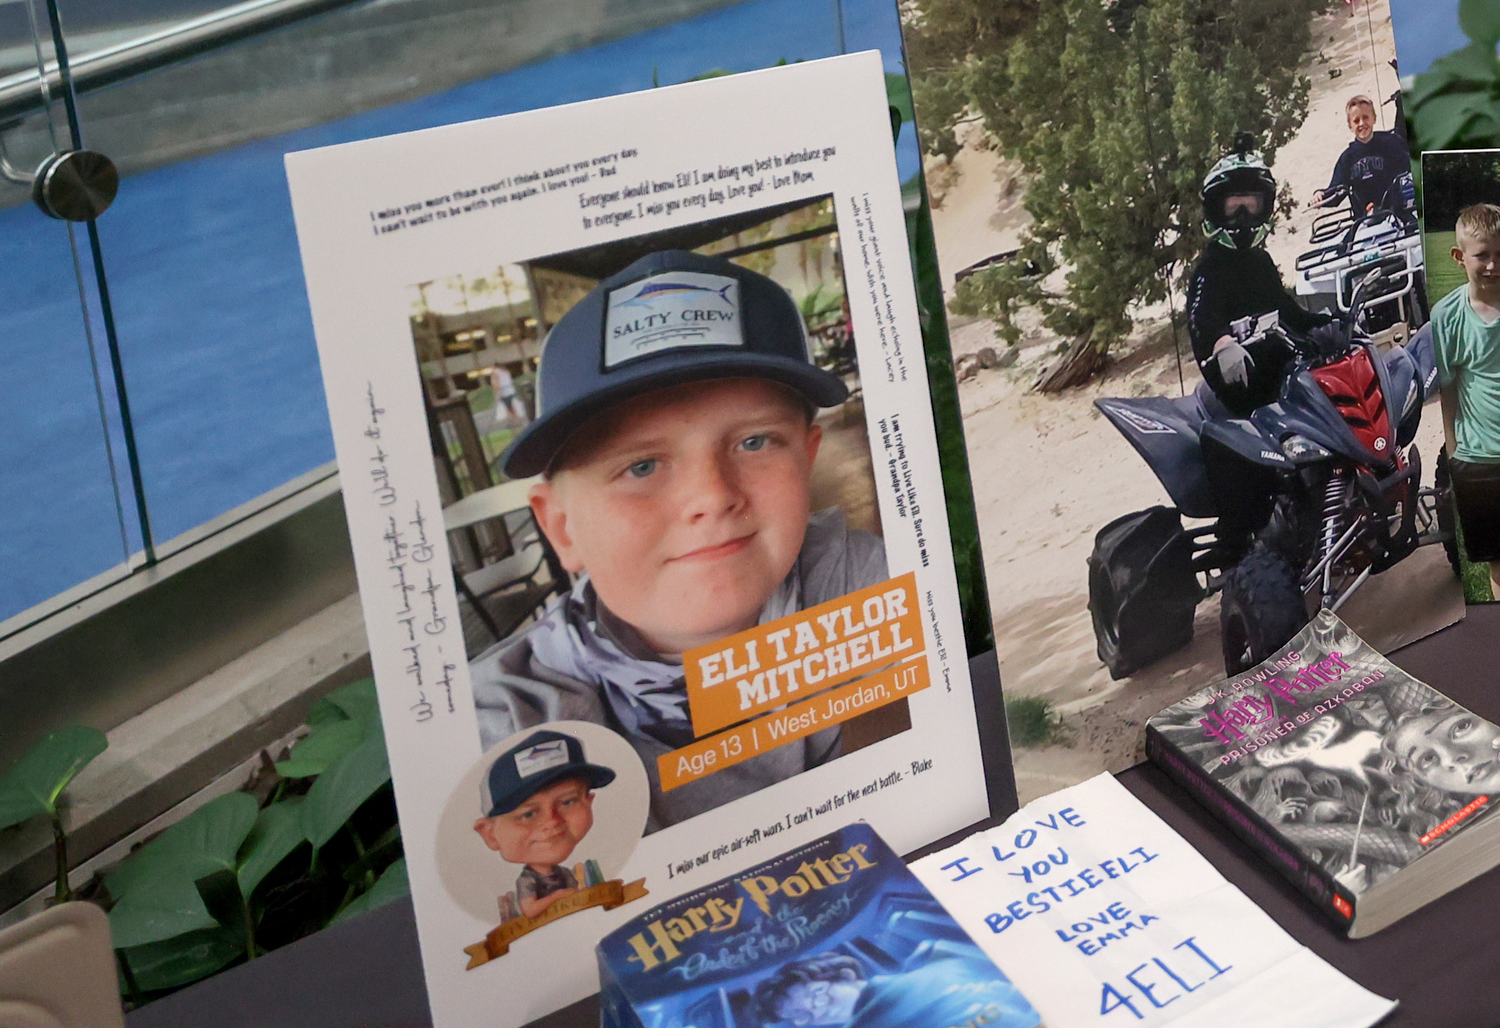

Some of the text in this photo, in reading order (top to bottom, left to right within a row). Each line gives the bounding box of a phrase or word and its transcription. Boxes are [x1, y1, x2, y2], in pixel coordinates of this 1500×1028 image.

[377, 207, 401, 219] miss
[404, 202, 422, 214] you
[425, 195, 450, 207] more
[452, 189, 478, 200] than
[513, 171, 540, 184] think
[543, 164, 569, 178] about
[573, 161, 589, 171] you
[592, 154, 617, 165] every
[579, 190, 619, 208] Everyone
[622, 180, 649, 199] should
[652, 181, 674, 193] know
[702, 172, 715, 182] am
[717, 165, 739, 180] doing
[741, 164, 754, 176] my
[755, 157, 771, 171] best
[773, 156, 781, 167] to
[784, 148, 820, 164] introduce
[822, 147, 835, 161] you
[380, 219, 406, 233] can't
[409, 213, 433, 226] wait
[436, 210, 447, 219] to
[449, 207, 461, 216] be
[463, 199, 488, 212] with
[490, 195, 507, 206] you
[548, 180, 567, 190] love
[569, 173, 588, 186] you!
[582, 217, 591, 229] to
[594, 209, 635, 226] everyone.
[646, 203, 663, 215] miss
[665, 200, 680, 215] you
[682, 194, 706, 207] every
[727, 185, 745, 198] Love
[748, 178, 763, 197] you!
[773, 175, 790, 189] Love
[793, 170, 814, 184] Mom
[865, 216, 874, 233] your
[869, 236, 881, 256] giant
[876, 258, 885, 279] voice
[850, 197, 860, 216] walls
[874, 305, 882, 325] were
[885, 356, 894, 382] Lacey
[881, 282, 890, 298] and
[613, 311, 671, 339] SALTY
[681, 310, 734, 322] CREW
[886, 299, 895, 323] laugh
[890, 325, 901, 356] echoing
[898, 357, 903, 365] in
[892, 420, 899, 432] am
[894, 433, 905, 460] trying
[878, 418, 906, 517] you bud. Grandpa Taylor
[901, 460, 908, 469] to
[903, 469, 911, 487] Live
[907, 487, 916, 505] Like
[914, 518, 922, 537] Sure
[918, 538, 925, 547] do
[920, 548, 929, 567] miss
[699, 587, 908, 688] ELI TAYLOR
[932, 621, 942, 647] bestie
[942, 667, 951, 692] Emma
[736, 622, 914, 711] MITCHELL
[1232, 650, 1300, 692] ROWLING
[1200, 652, 1352, 744] Harry Potter
[1220, 721, 1298, 765] PRISONER
[1296, 711, 1314, 725] OF
[1314, 670, 1386, 714] AZKABAN
[676, 666, 918, 777] Age 13 West Jordan, UT
[676, 859, 694, 874] miss
[695, 851, 710, 866] our
[712, 844, 729, 860] epic
[730, 828, 760, 852] air-soft
[762, 822, 784, 838] wars.
[793, 806, 812, 824] can't
[814, 799, 832, 815] wait
[833, 794, 845, 809] for
[847, 789, 860, 802] the
[862, 780, 877, 796] next
[879, 771, 902, 789] battle.
[910, 759, 932, 775] Blake
[940, 807, 1087, 882] I LOVE
[1008, 847, 1069, 883] YOU
[626, 894, 744, 972] Harry
[741, 841, 878, 916] Potter
[1056, 901, 1132, 942] LOVE
[1077, 914, 1160, 956] EMMA
[1100, 937, 1232, 1019] 4ELI
